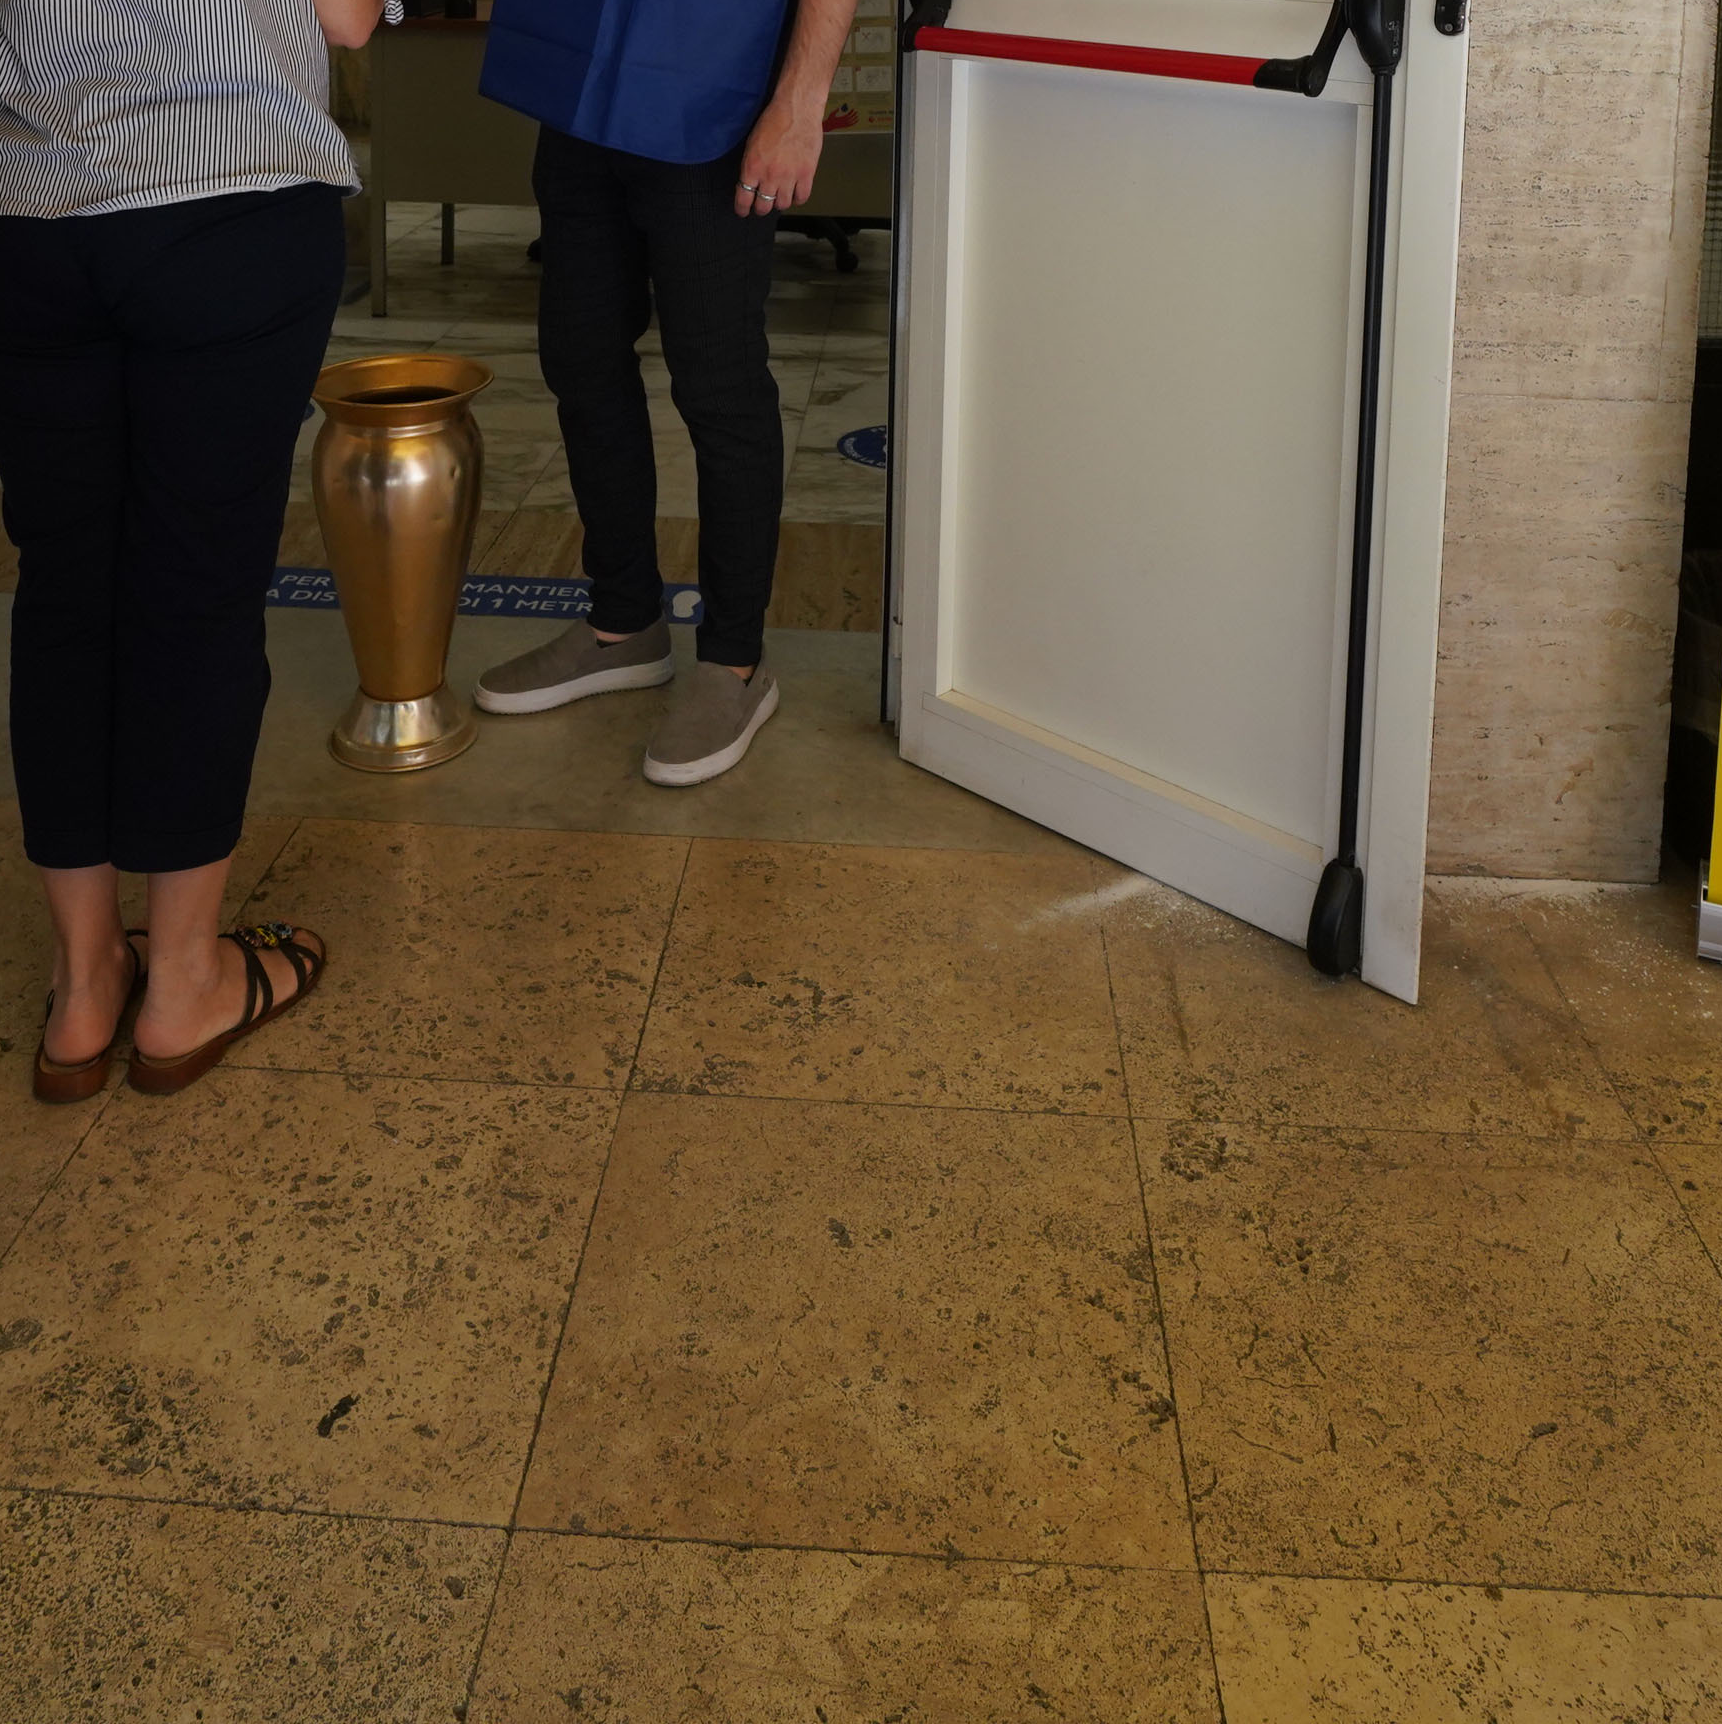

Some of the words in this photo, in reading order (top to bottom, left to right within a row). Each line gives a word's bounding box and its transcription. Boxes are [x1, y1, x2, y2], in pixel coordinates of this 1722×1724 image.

[279, 574, 332, 587] PER
[460, 581, 592, 598] MANTIEN
[492, 597, 502, 609] 1
[514, 599, 594, 613] METR
